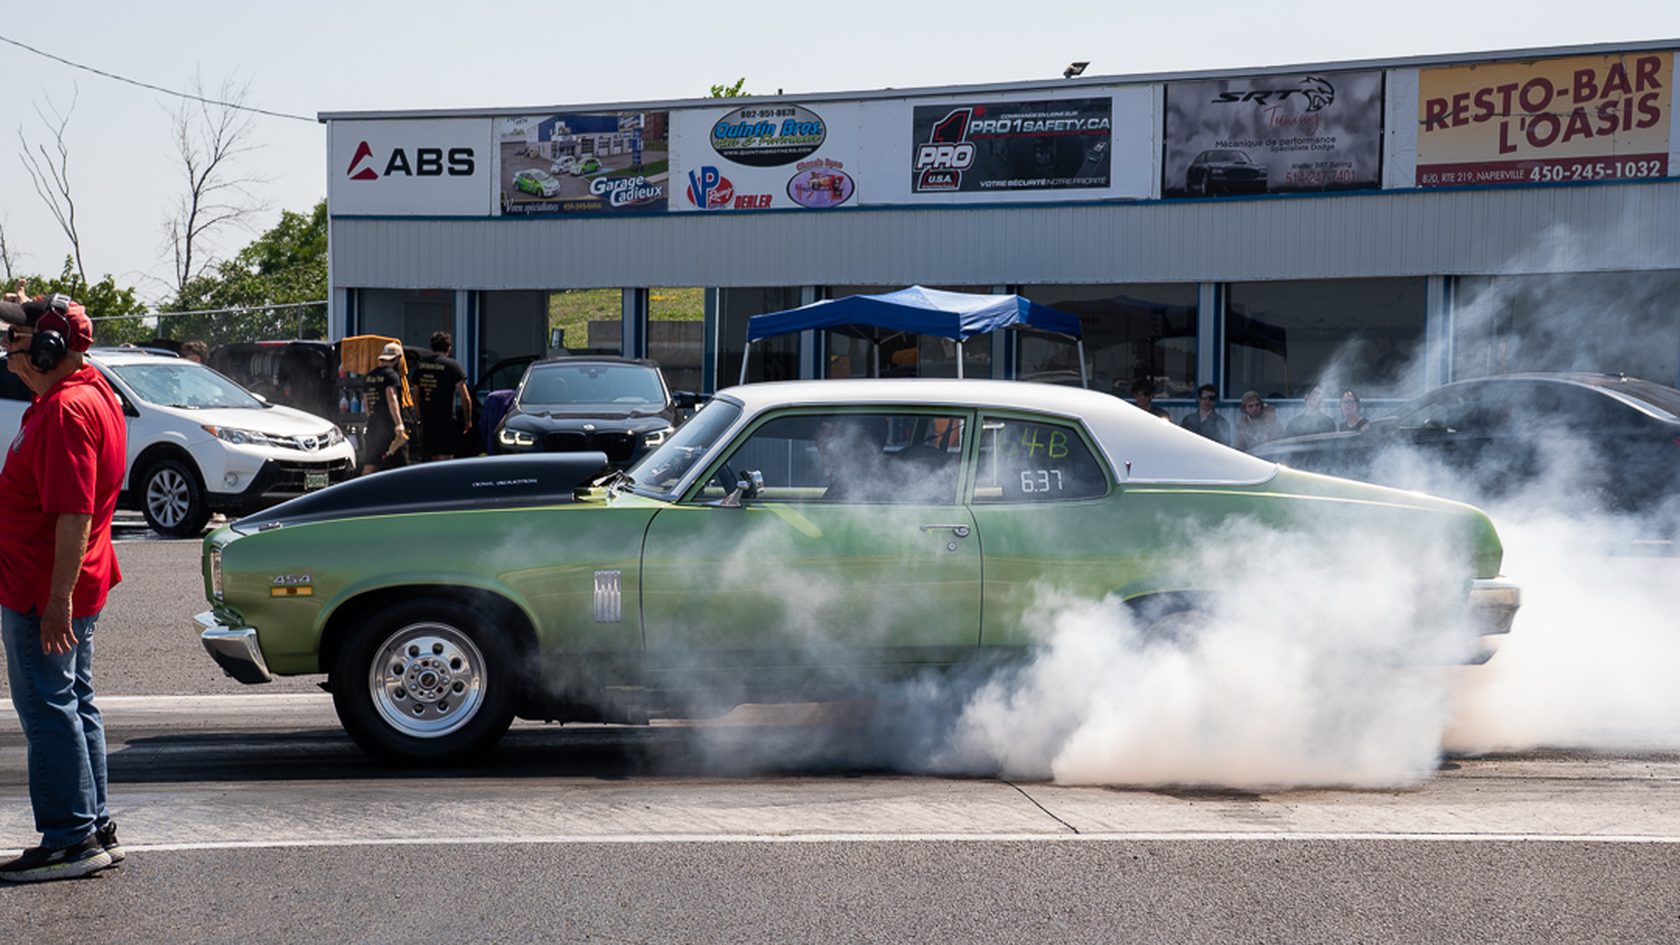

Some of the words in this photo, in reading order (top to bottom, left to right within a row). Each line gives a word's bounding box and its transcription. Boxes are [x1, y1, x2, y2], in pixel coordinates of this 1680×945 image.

[1211, 88, 1303, 105] SRT
[1425, 56, 1662, 132] RESTO-BAR
[714, 121, 776, 139] Quintin
[779, 119, 823, 137] Bros.
[970, 118, 1109, 134] PRO1SAFETY.CA
[1499, 92, 1661, 154] L'OASIS
[1265, 138, 1274, 146] de
[1276, 136, 1337, 148] performance
[383, 147, 475, 176] ABS
[917, 146, 974, 169] PRO
[1441, 172, 1456, 182] RTE
[1530, 160, 1661, 182] 450-245-1032
[589, 176, 644, 195] Garage
[689, 166, 720, 209] VP
[610, 186, 663, 207] Cadieux
[734, 195, 772, 209] DEALER
[1021, 470, 1063, 493] 6.37
[273, 574, 311, 584] 454
